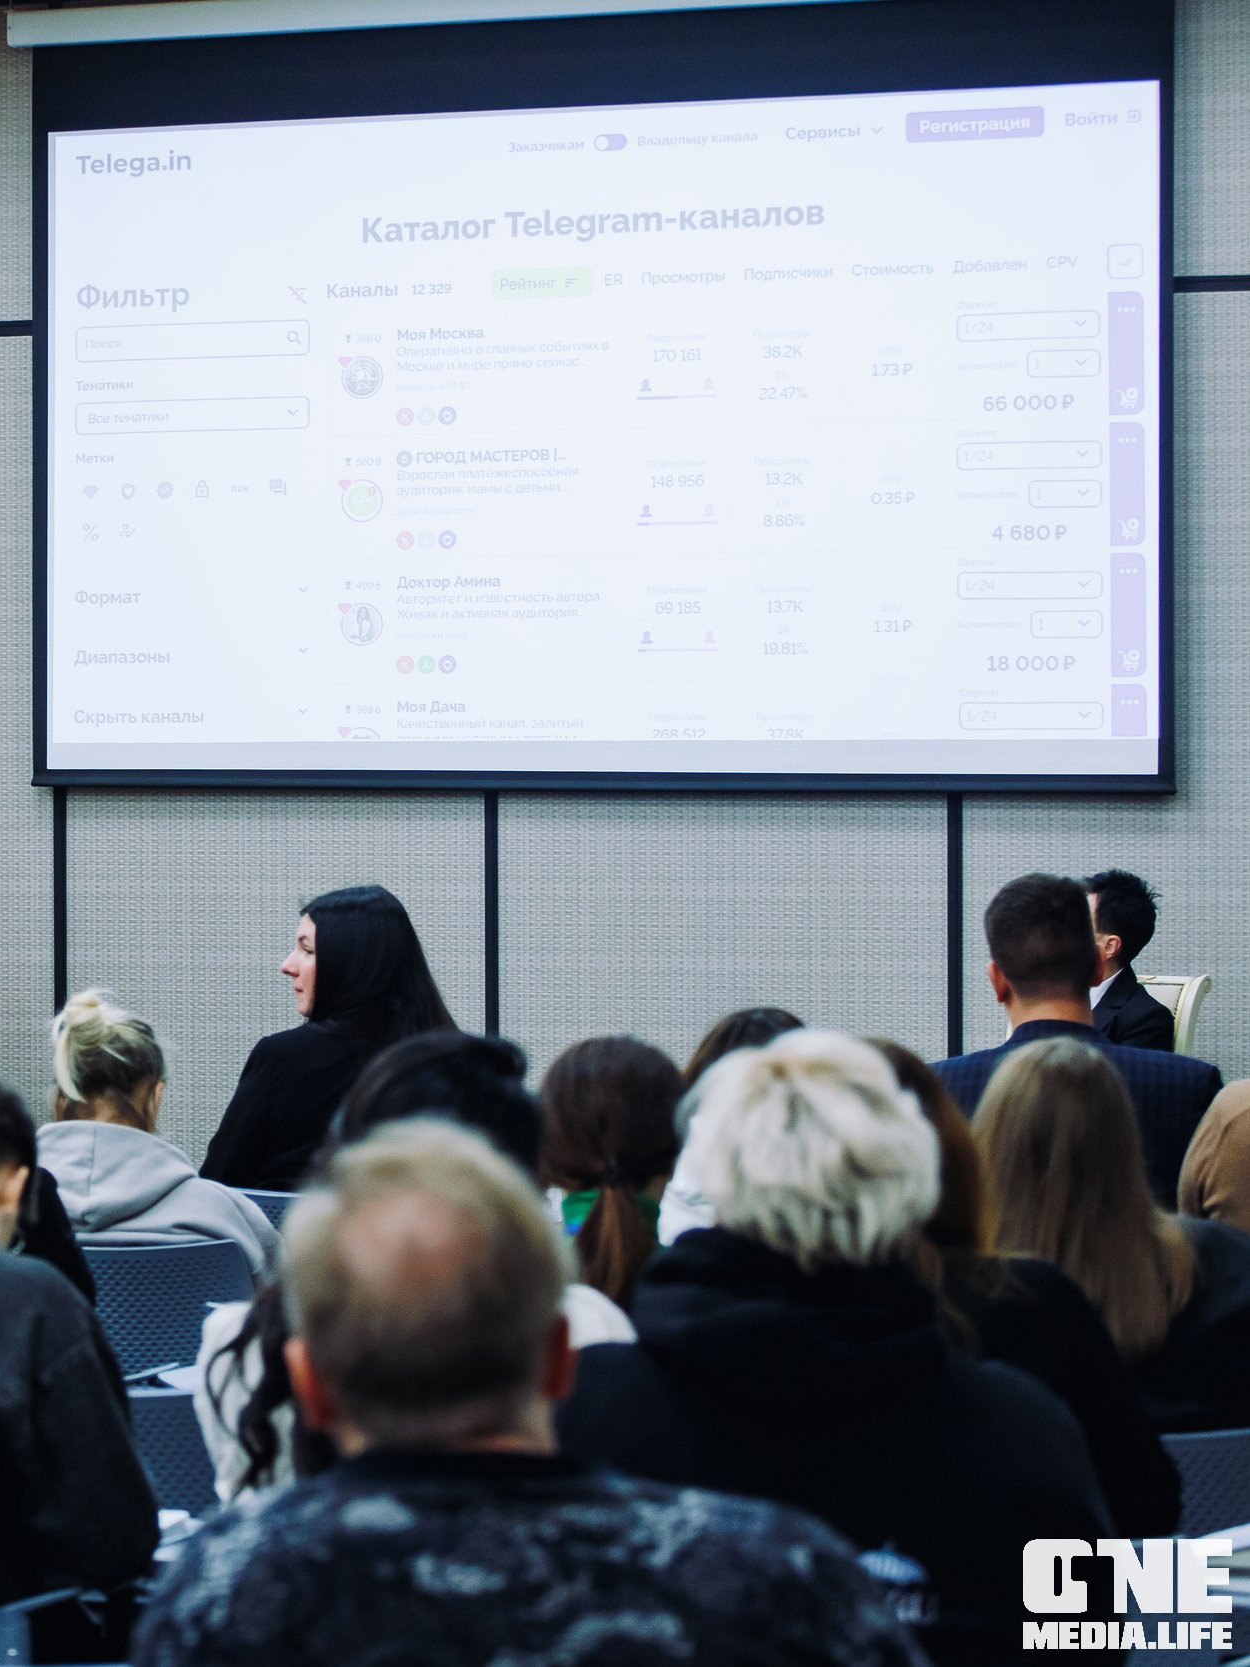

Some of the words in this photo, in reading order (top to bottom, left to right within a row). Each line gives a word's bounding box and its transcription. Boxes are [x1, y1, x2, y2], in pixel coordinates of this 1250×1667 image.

[918, 116, 1031, 135] Регистрация
[1064, 110, 1118, 126] Войти
[637, 133, 708, 149] Владельцу
[711, 131, 758, 144] канала
[785, 125, 861, 142] Сервисы
[508, 140, 585, 153] Заказчикам
[76, 150, 192, 178] Telega.in
[361, 214, 496, 244] Каталог
[504, 204, 825, 242] Telegram-каналов
[952, 257, 1028, 275] Добавлен
[1046, 255, 1078, 269] CPV
[744, 267, 834, 282] Подписчики
[851, 262, 935, 278] Стоимость
[499, 277, 558, 291] Рейтинг
[604, 273, 623, 286] ER
[641, 271, 726, 287] Просмотры
[76, 284, 190, 312] Фильтр
[326, 283, 399, 299] Каналы
[396, 329, 427, 341] Моя
[430, 327, 485, 340] Москва
[396, 345, 473, 358] Оперативно
[652, 349, 677, 363] 170
[680, 348, 702, 361] 161
[396, 360, 444, 372] Москве
[75, 379, 134, 392] Тематики
[983, 395, 1008, 412] 66
[1013, 395, 1058, 411] 000
[87, 413, 111, 425] Все
[113, 412, 169, 423] тематики
[75, 453, 115, 464] Метки
[416, 451, 467, 465] ГОРОД
[469, 449, 550, 463] МАСТЕРОВ
[396, 469, 455, 482] Взрослая
[650, 475, 674, 488] 148
[677, 474, 704, 487] 956
[467, 485, 501, 495] мамы
[992, 525, 1004, 541] 4
[1010, 525, 1051, 541] 680
[396, 576, 451, 591] Доктор
[453, 575, 501, 588] Амина
[75, 590, 141, 608] Формат
[655, 601, 674, 614] 69
[677, 601, 701, 614] 185
[74, 650, 171, 666] Диапазоны
[986, 655, 1010, 672] 18
[1015, 655, 1060, 671] 000
[396, 701, 427, 713] Моя
[429, 700, 467, 714] Дача
[73, 709, 137, 728] Скрыть
[140, 710, 205, 724] каналы
[396, 716, 486, 730] Качественный
[766, 728, 805, 738] 378K
